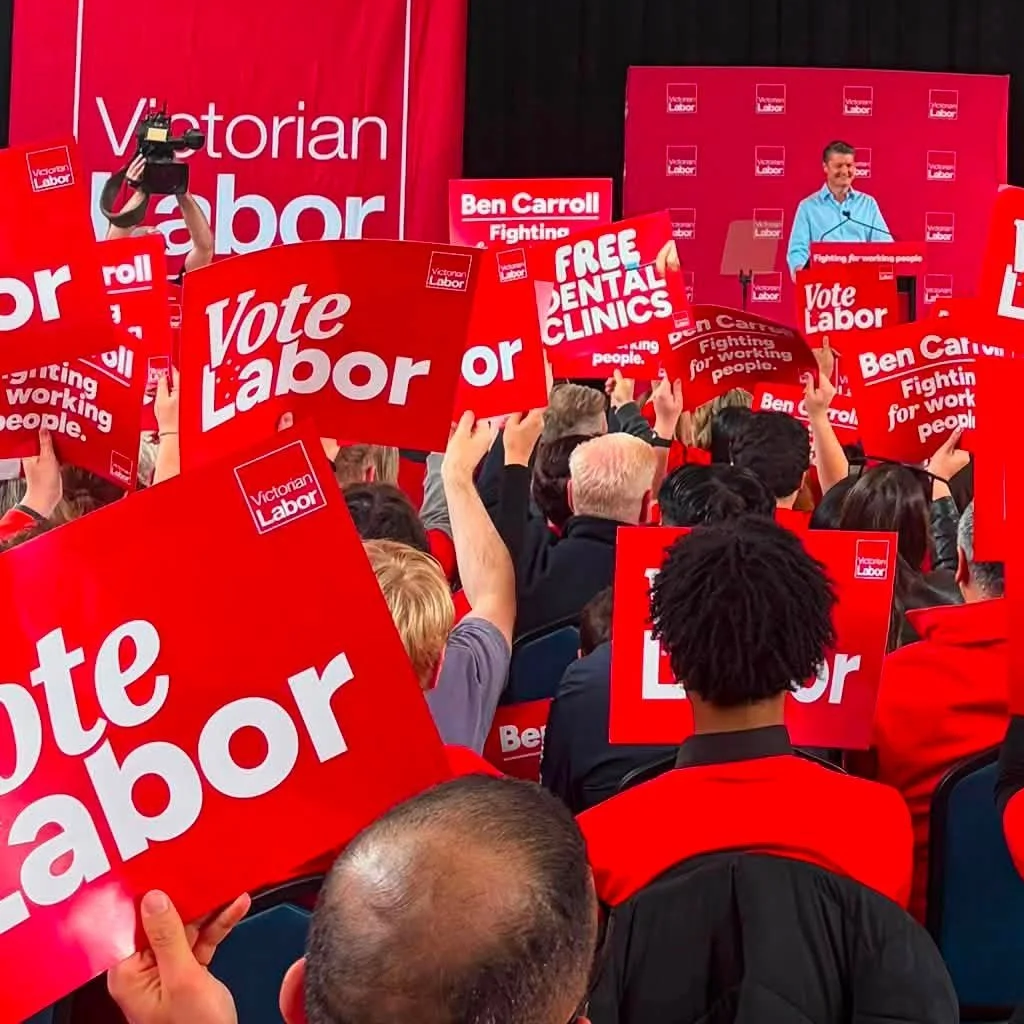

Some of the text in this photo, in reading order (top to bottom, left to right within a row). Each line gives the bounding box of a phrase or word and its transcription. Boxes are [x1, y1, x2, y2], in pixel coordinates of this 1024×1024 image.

[668, 103, 695, 112] Labor
[757, 104, 784, 113] Labor
[845, 105, 870, 114] Labor
[930, 108, 956, 118] Labor
[96, 96, 388, 161] Vtorian
[33, 173, 71, 189] Labor
[668, 166, 695, 175] Labor
[756, 166, 784, 175] Labor
[928, 169, 954, 179] Labor
[461, 192, 600, 215] Ben Carroll
[672, 228, 693, 238] abor
[754, 228, 780, 238] Labor
[927, 232, 952, 241] Labor
[555, 228, 641, 283] FREE
[813, 253, 847, 264] Fighting
[862, 253, 894, 264] working
[896, 253, 923, 264] people
[102, 254, 152, 286] roll
[429, 275, 465, 288] Labor
[500, 269, 525, 281] Labor
[753, 291, 780, 301] Labor
[804, 282, 857, 311] Vote
[205, 283, 351, 369] Vote
[541, 290, 673, 346] CLINICS
[804, 307, 888, 335] Labor
[699, 335, 776, 354] Fighting
[592, 350, 645, 367] people.
[690, 356, 714, 381] for
[717, 346, 793, 362] working
[858, 347, 916, 380] Ben
[712, 360, 778, 384] people.
[901, 366, 976, 399] Fightin
[202, 339, 431, 433] Labor
[6, 387, 113, 433] working
[761, 391, 794, 413] Ben
[888, 388, 976, 432] for work
[918, 409, 976, 443] peopl
[249, 473, 314, 507] Victorian
[256, 489, 318, 528] Labor
[856, 565, 886, 577] Labor
[0, 619, 170, 797] ote
[500, 725, 547, 752] Be
[0, 651, 355, 935] abor
